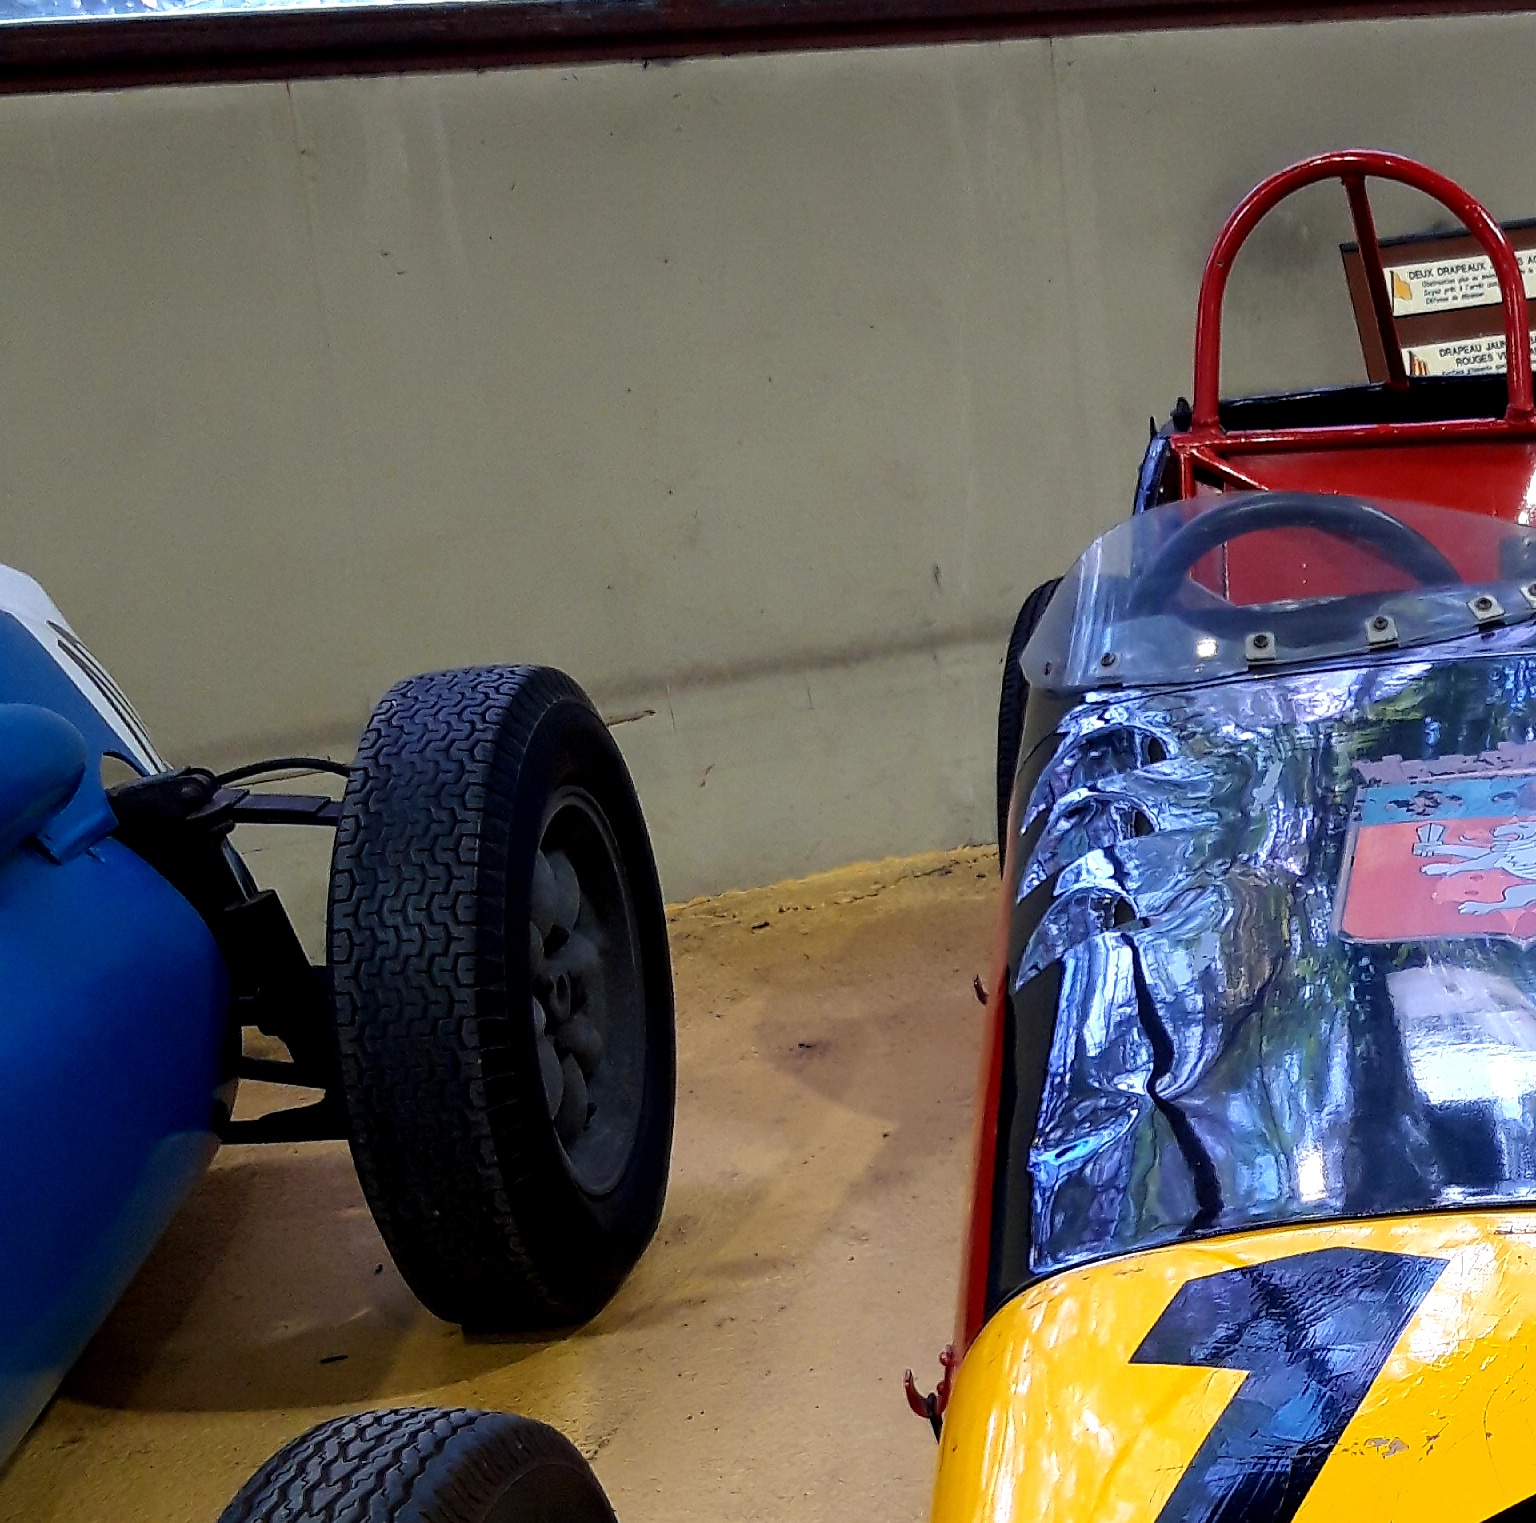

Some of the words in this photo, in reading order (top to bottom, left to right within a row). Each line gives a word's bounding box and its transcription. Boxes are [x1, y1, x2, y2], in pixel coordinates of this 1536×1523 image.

[1408, 269, 1434, 280] DEUX
[1437, 262, 1486, 276] DRAPEAUX
[1439, 344, 1482, 358] DRAPEAU
[1456, 353, 1494, 367] ROUGES
